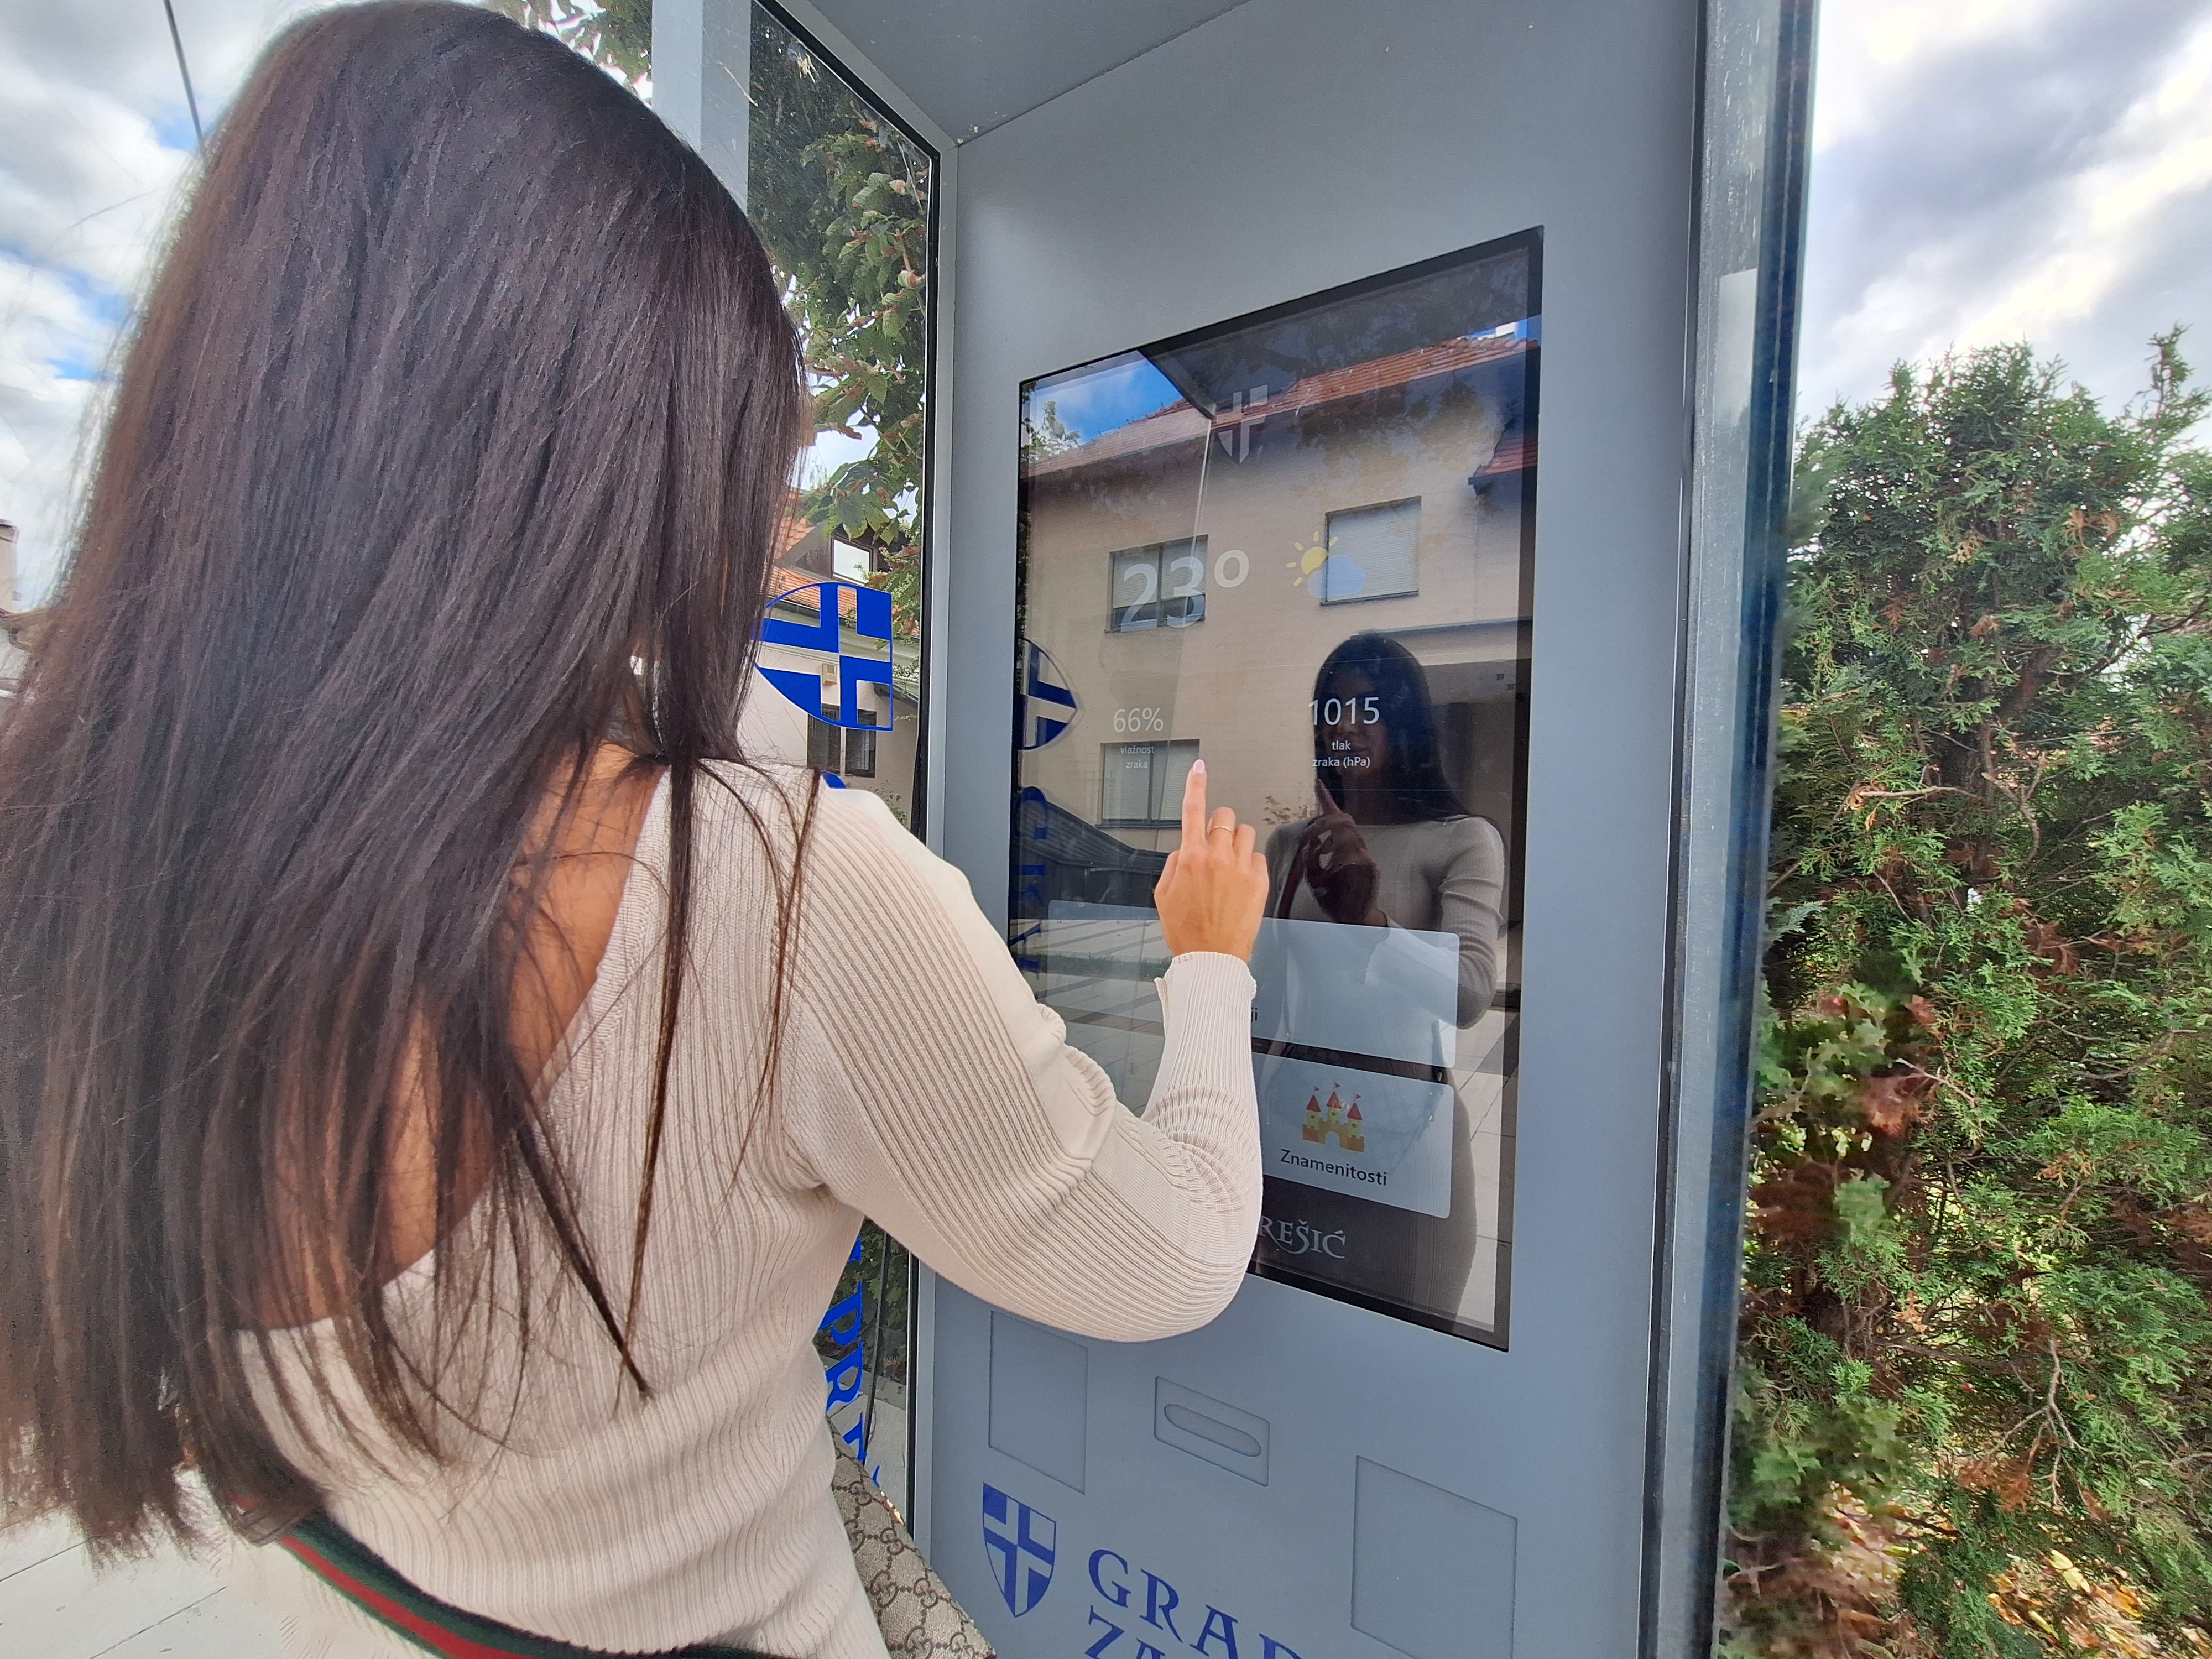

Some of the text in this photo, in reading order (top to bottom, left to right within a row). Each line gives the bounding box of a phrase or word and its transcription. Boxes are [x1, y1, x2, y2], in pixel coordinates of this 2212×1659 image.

[1113, 707, 1164, 733] 66%
[1308, 696, 1380, 726] 1015
[1120, 745, 1155, 754] vlažnost
[1332, 739, 1352, 751] tlak
[1125, 759, 1148, 769] zraka
[1312, 755, 1371, 769] zraka (hPa)
[1280, 1148, 1387, 1186] Znamenitosti
[1258, 1215, 1346, 1259] REŠIĆ
